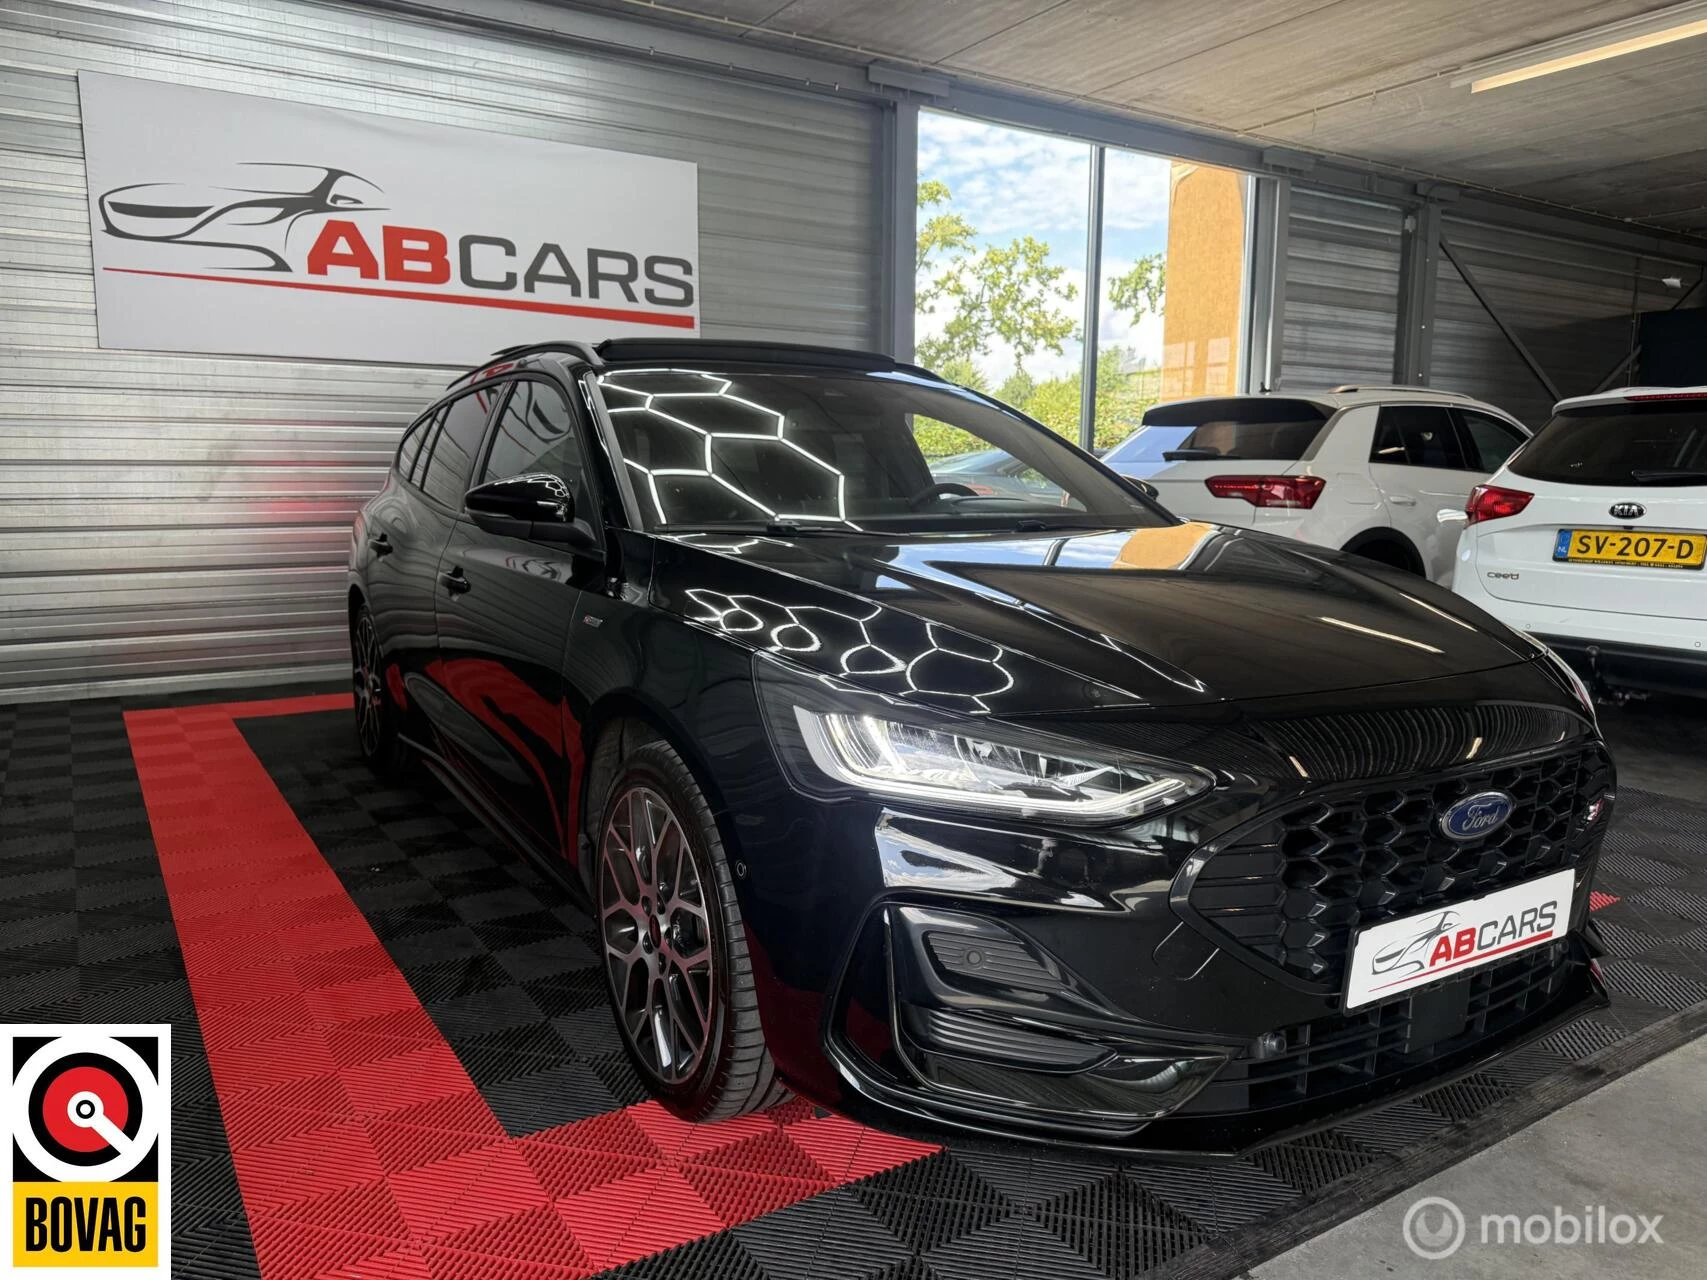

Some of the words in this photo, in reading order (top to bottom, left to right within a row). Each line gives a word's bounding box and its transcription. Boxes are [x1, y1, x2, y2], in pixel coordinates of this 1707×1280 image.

[307, 219, 694, 308] ABCARS
[1614, 505, 1639, 516] KIA
[1576, 535, 1694, 560] SV-207-D
[1461, 802, 1500, 831] Ford
[1429, 900, 1558, 967] ABCARS
